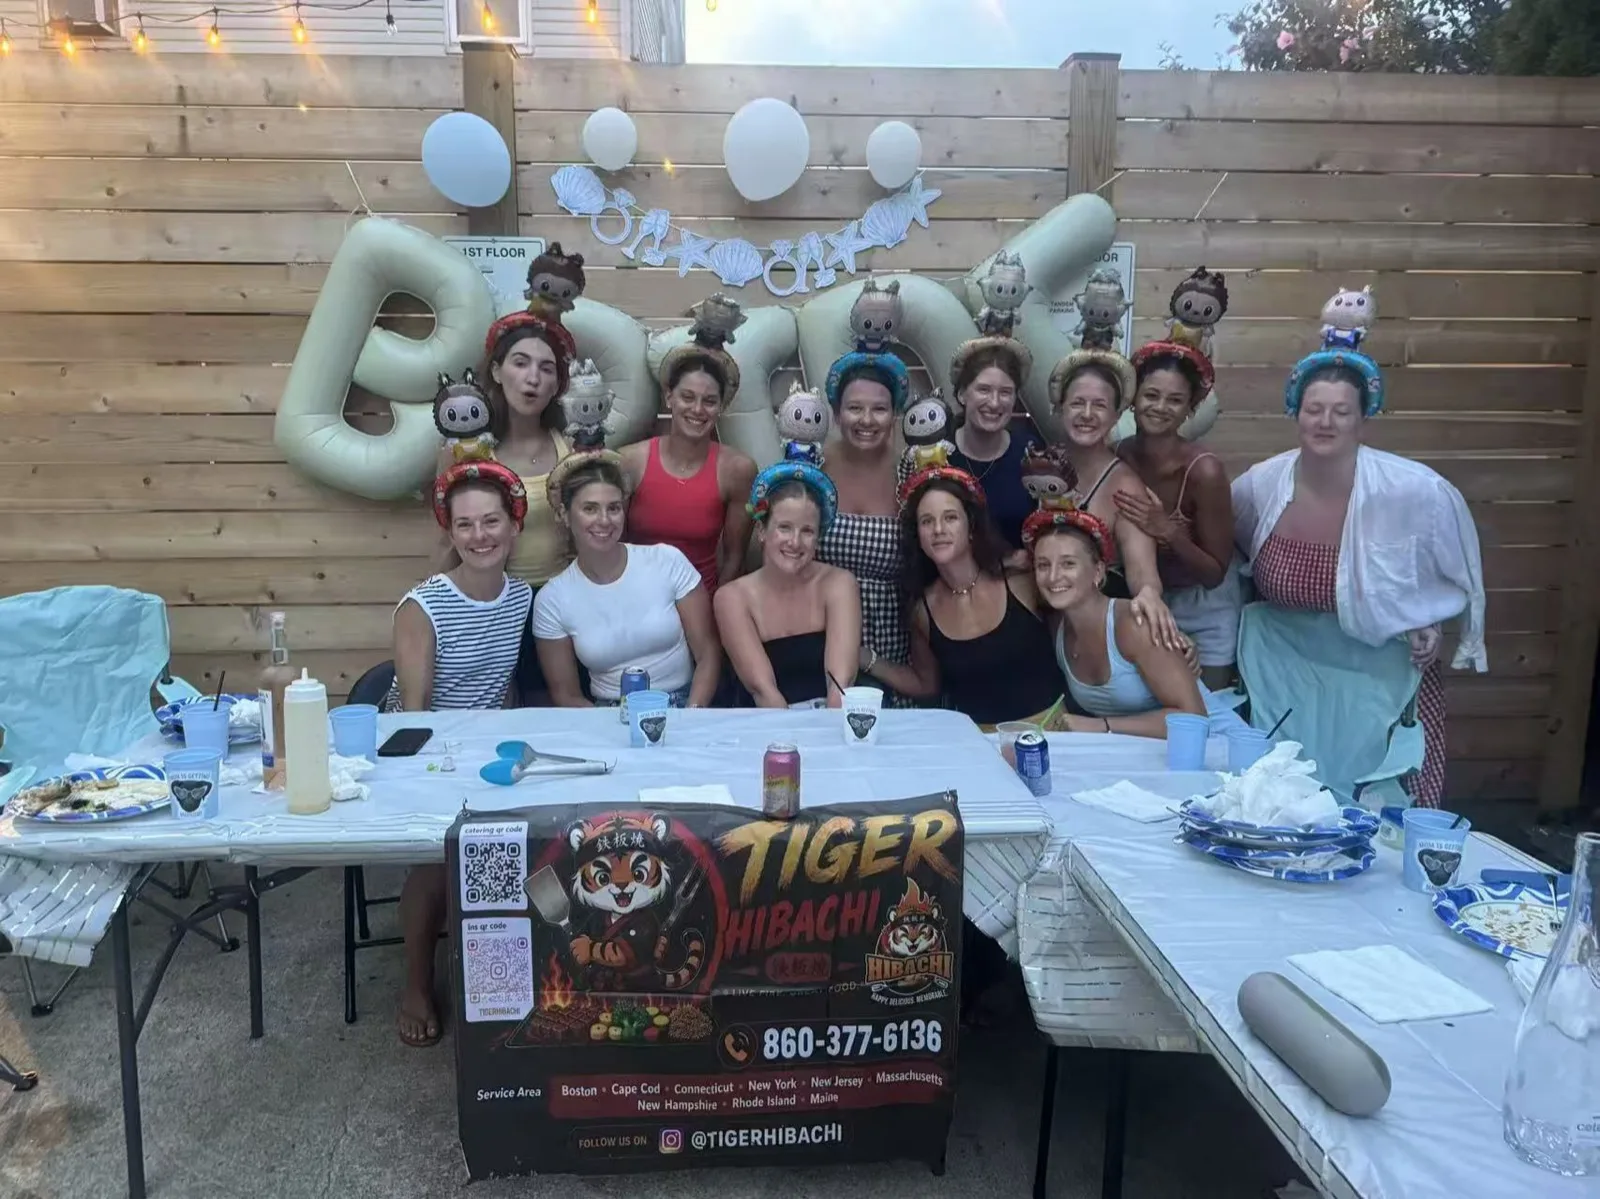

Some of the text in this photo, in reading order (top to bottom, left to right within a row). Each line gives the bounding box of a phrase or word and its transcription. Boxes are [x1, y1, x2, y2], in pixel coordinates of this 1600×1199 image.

[463, 247, 526, 258] 1ST FLOOR
[464, 825, 523, 836] catering qr code
[714, 809, 961, 904] TIGER
[480, 924, 488, 932] qr
[489, 922, 507, 930] code
[724, 888, 881, 959] HIBACHI
[868, 955, 951, 981] HIBACHI
[479, 1007, 521, 1016] TIGERHIBACHI
[763, 1018, 942, 1060] 860-377-6136
[476, 1087, 542, 1101] Service Area
[561, 1068, 943, 1098] Boston Cape Cod Connecticut New York New Jersey Massachusetts
[637, 1092, 839, 1112] New Hampshire Rhode Island Maine
[578, 1122, 842, 1150] FOLLOW US ON @TIGERHIBACHI
